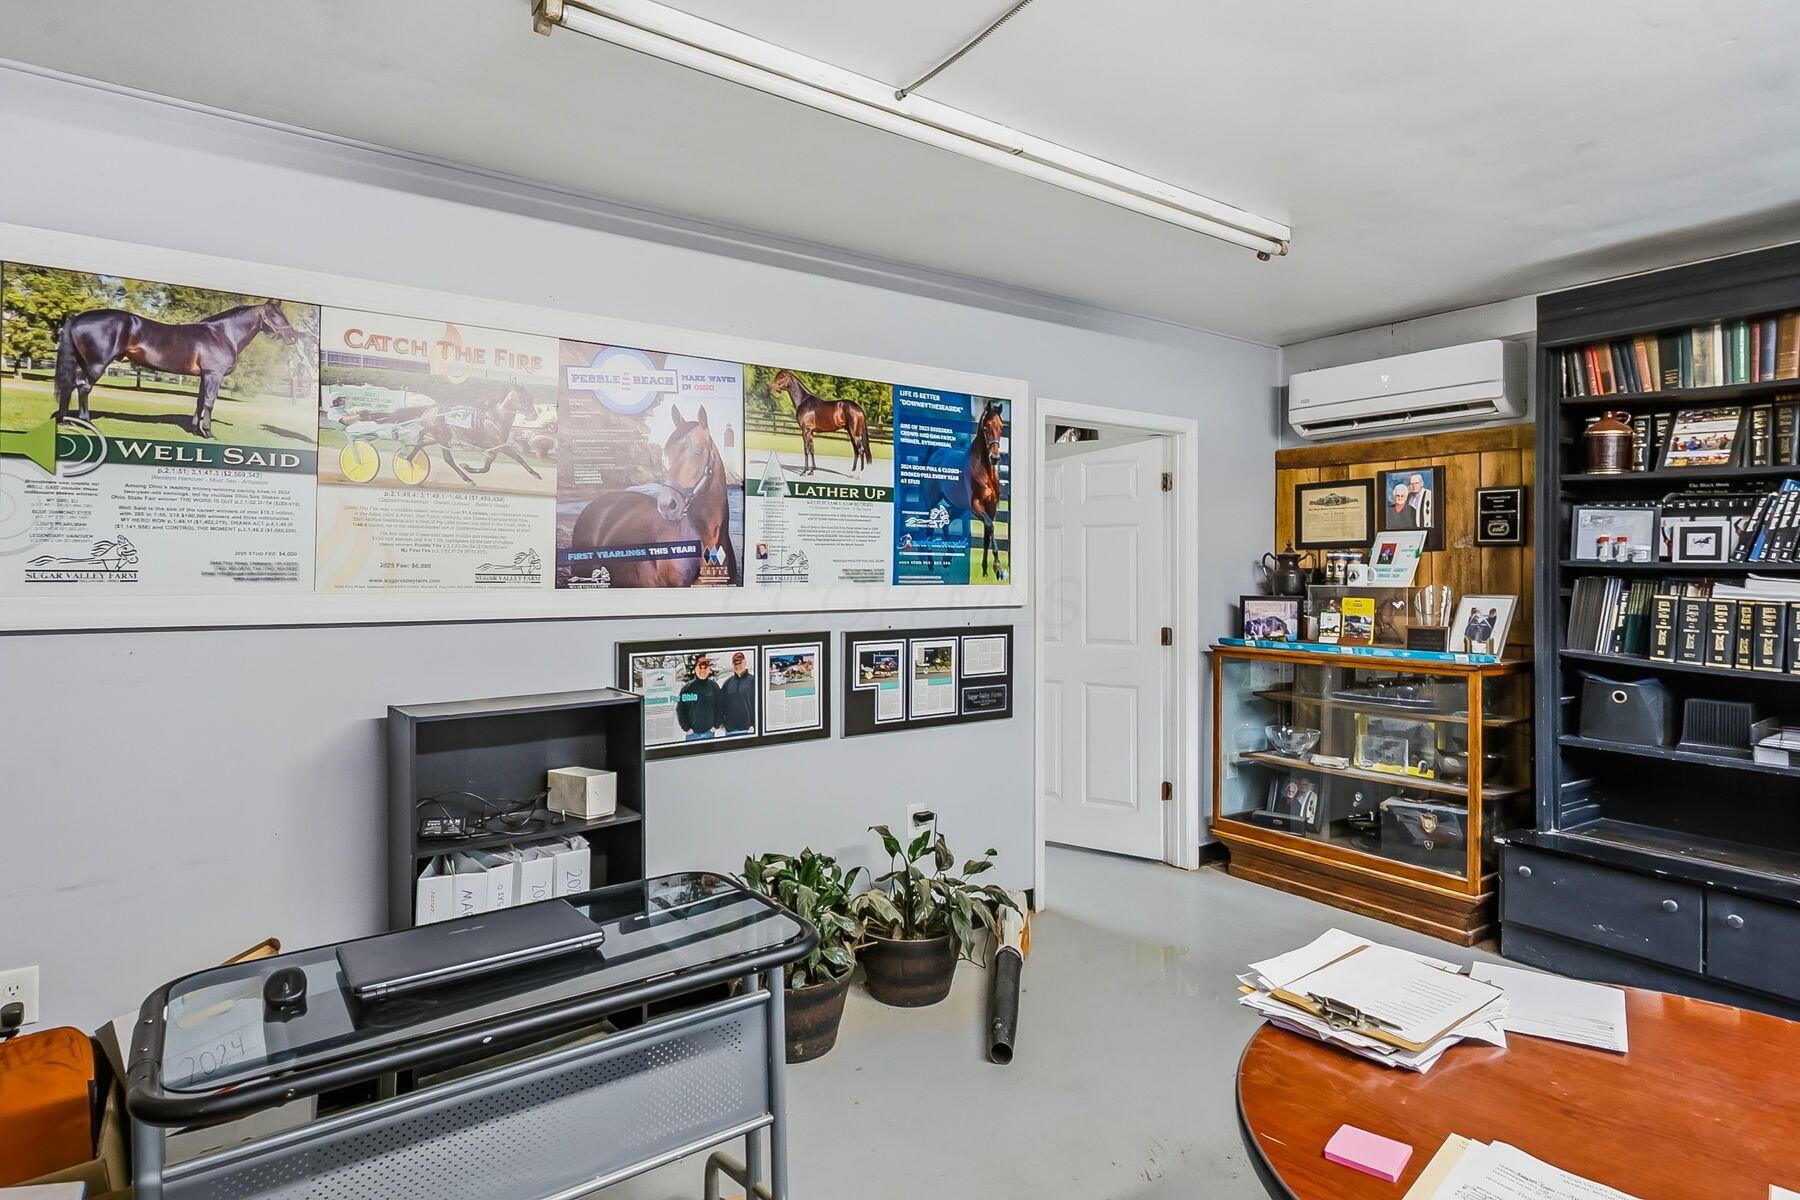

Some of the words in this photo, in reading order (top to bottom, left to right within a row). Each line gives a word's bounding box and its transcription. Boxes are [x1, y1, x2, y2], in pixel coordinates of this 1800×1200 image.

[344, 328, 427, 356] CATCH
[437, 340, 486, 364] THE
[494, 348, 544, 374] FIRE
[570, 373, 620, 384] PEBBLE
[633, 375, 674, 386] BEACH
[681, 374, 706, 382] MAKE
[708, 375, 736, 383] WAVES
[681, 383, 691, 391] IN
[919, 393, 941, 401] BETTER
[114, 441, 213, 464] WELL
[223, 448, 301, 467] SAID
[794, 483, 859, 499] LATHER
[864, 487, 886, 500] UP
[567, 552, 593, 561] FIRST
[597, 548, 647, 559] YEARLINGS
[648, 547, 669, 555] THIS
[671, 545, 696, 554] YEAR!
[26, 572, 63, 580] SUGAR
[65, 572, 105, 580] VALLEY
[108, 572, 138, 581] FARM
[681, 692, 698, 702] Ohio
[180, 1036, 245, 1084] 2024
